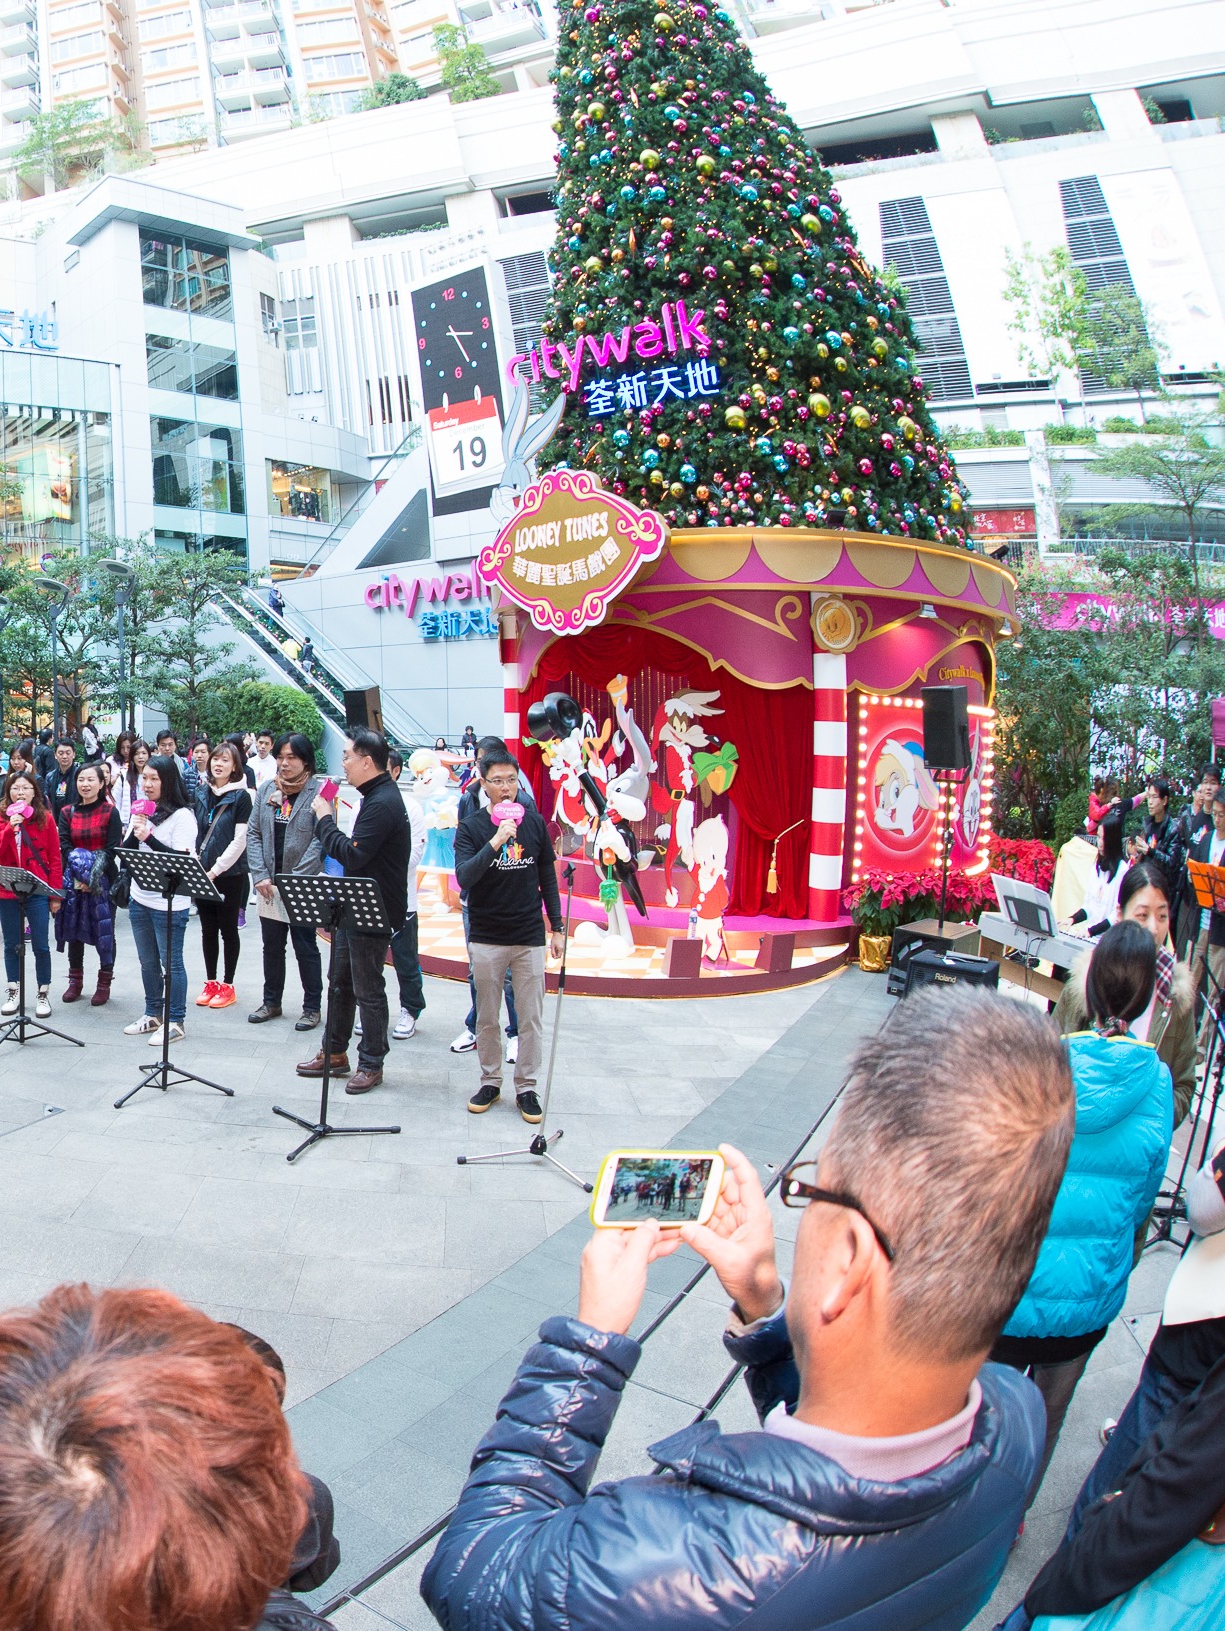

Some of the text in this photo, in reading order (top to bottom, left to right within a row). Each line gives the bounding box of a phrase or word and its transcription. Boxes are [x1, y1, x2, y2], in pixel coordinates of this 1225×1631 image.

[441, 287, 455, 301] 12
[481, 316, 490, 330] 3
[418, 337, 427, 350] 9
[506, 299, 712, 391] citywalk
[454, 366, 463, 379] 6
[584, 358, 720, 416] 荃新天地
[453, 436, 487, 471] 19
[514, 511, 609, 553] LOONEY TUNES
[364, 558, 491, 619] citywal
[934, 972, 957, 984] Roland
